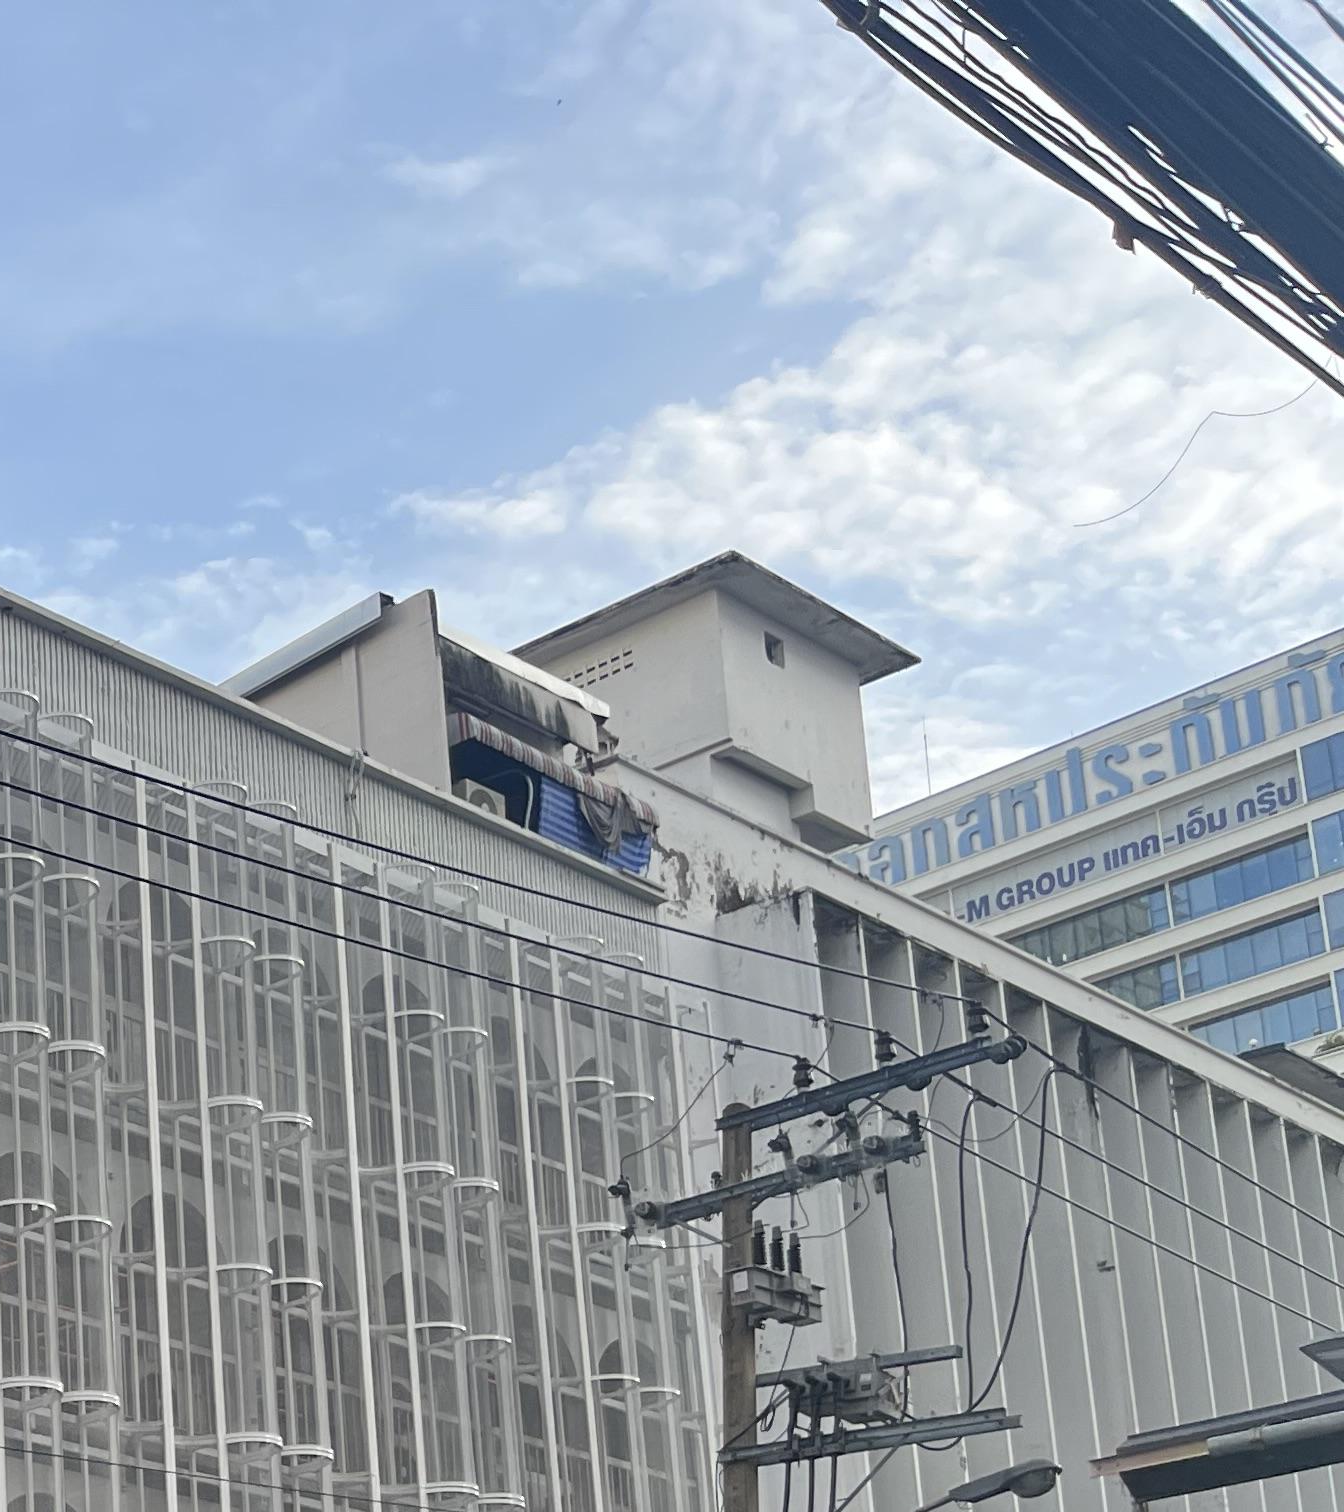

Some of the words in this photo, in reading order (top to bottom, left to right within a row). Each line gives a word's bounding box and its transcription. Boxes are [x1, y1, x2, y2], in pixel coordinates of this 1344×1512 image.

[838, 650, 1344, 884] อกสหประกันภั
[996, 857, 1095, 912] GROUP
